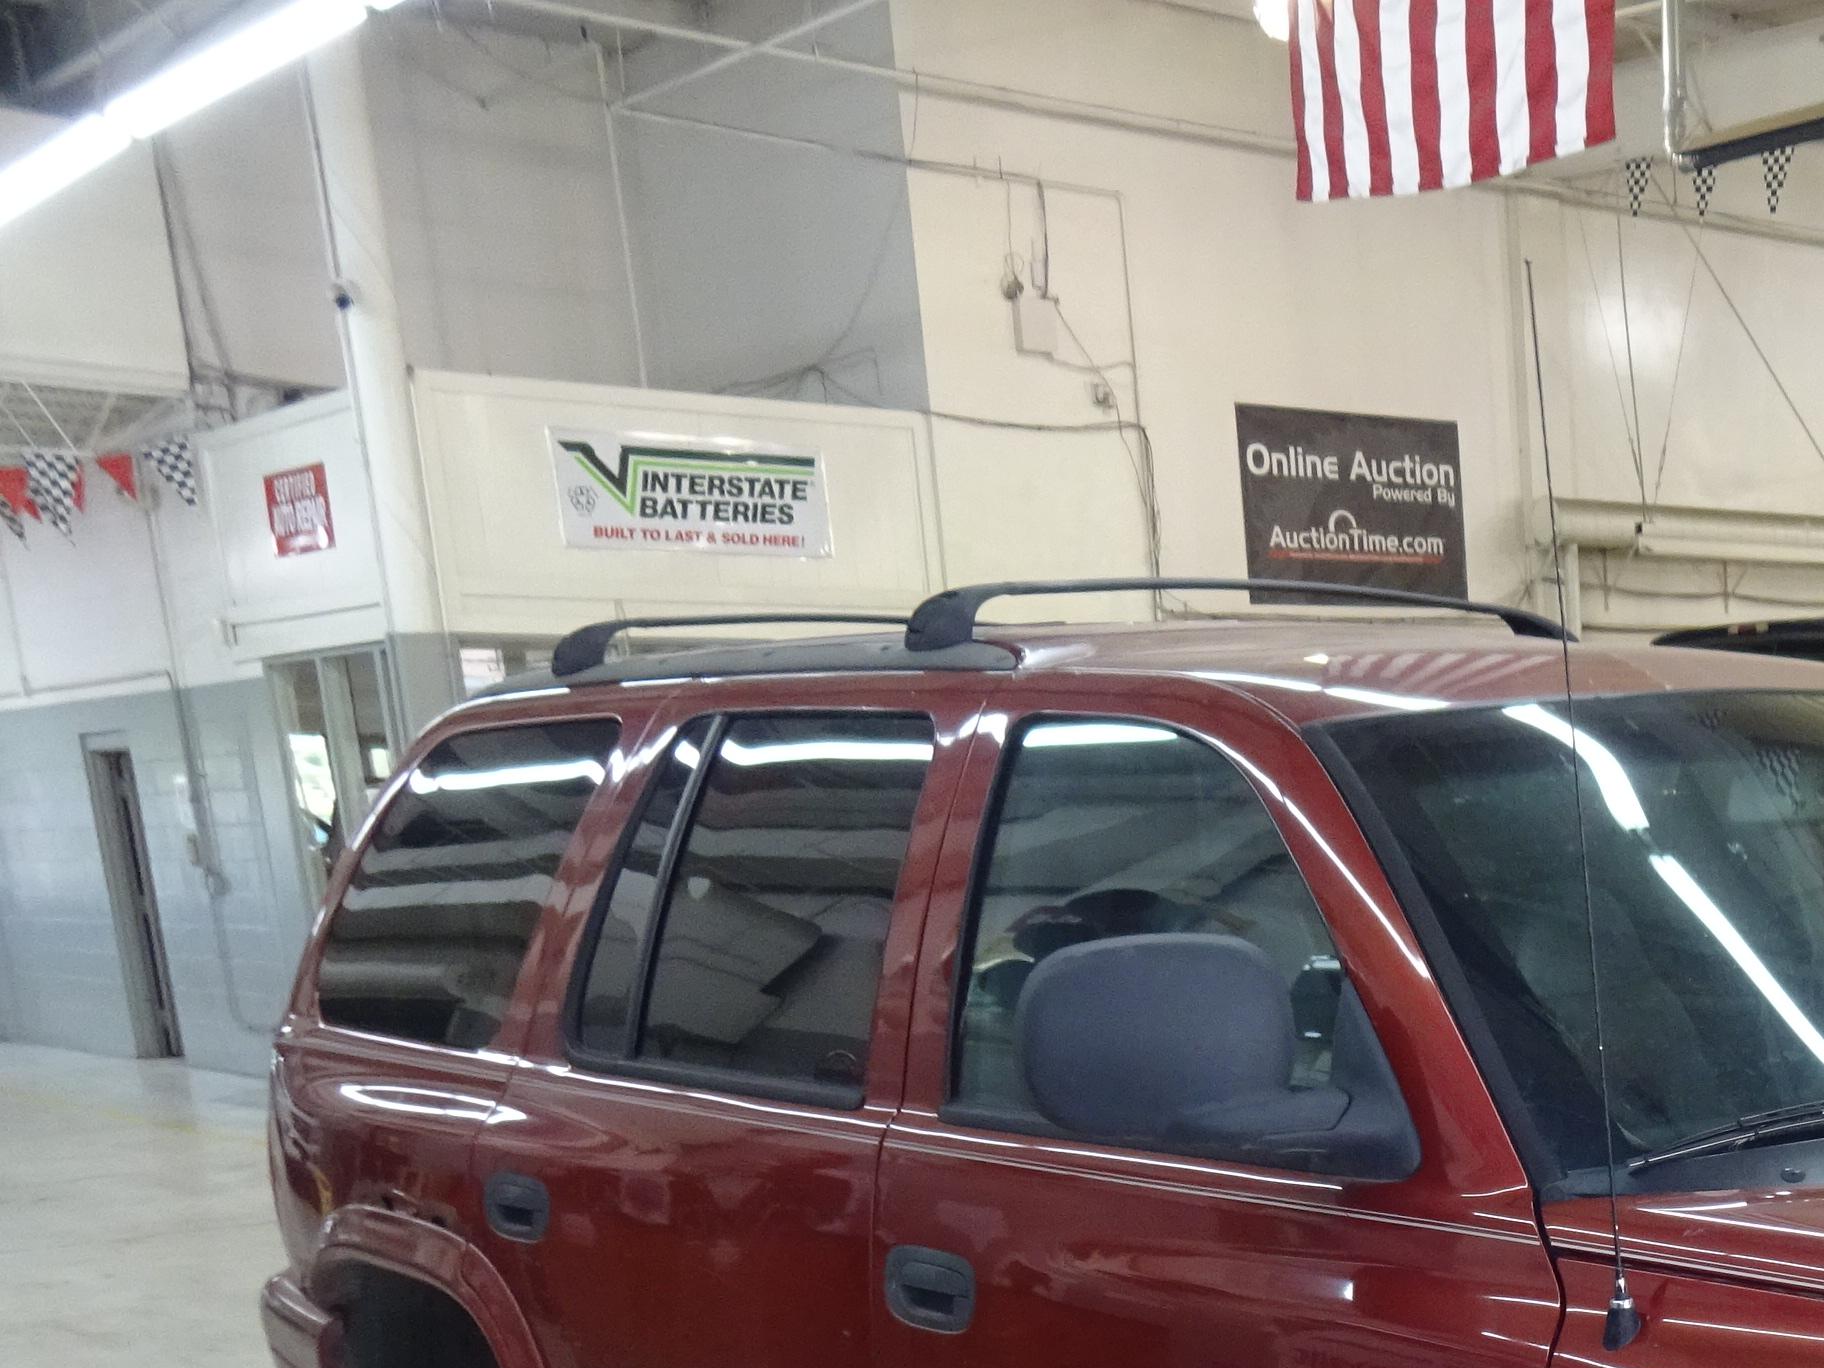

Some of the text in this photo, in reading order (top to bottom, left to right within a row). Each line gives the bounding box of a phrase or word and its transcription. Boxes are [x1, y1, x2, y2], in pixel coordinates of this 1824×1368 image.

[1246, 442, 1456, 487] Online Auction
[641, 470, 808, 502] INTERSTATE
[1372, 483, 1456, 507] Powered By
[639, 496, 795, 525] BATTERIES
[592, 524, 806, 548] BUILT TO LAST & SOLD HERE!
[1269, 520, 1445, 556] AuctionTime.com
